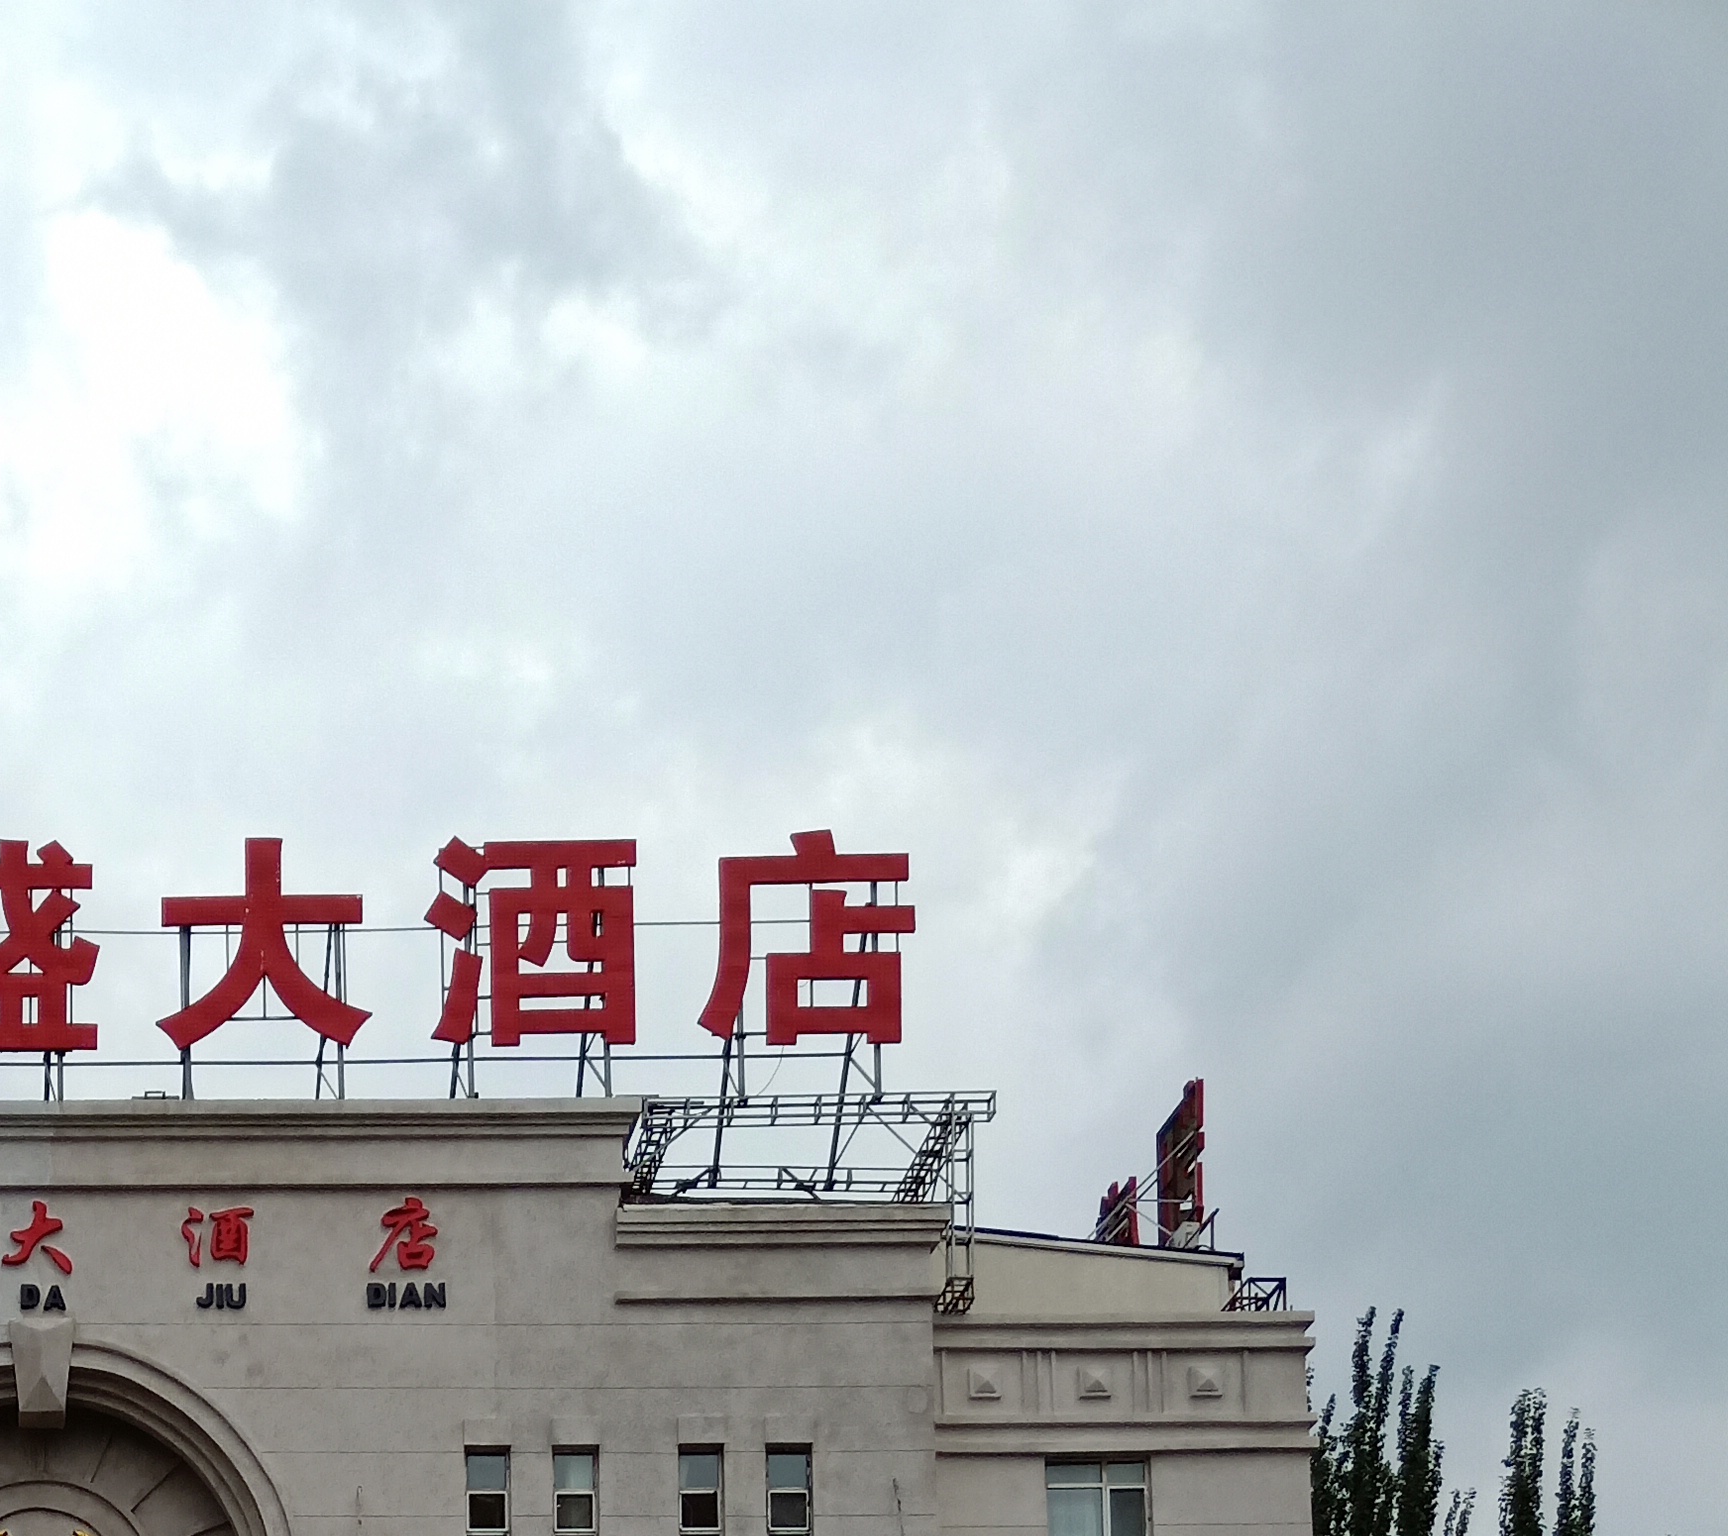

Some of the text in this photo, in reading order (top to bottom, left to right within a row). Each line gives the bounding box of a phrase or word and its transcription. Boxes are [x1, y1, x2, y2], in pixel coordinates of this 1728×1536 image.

[19, 1282, 67, 1313] DA
[195, 1282, 247, 1312] JIU
[366, 1282, 447, 1312] DIAN
